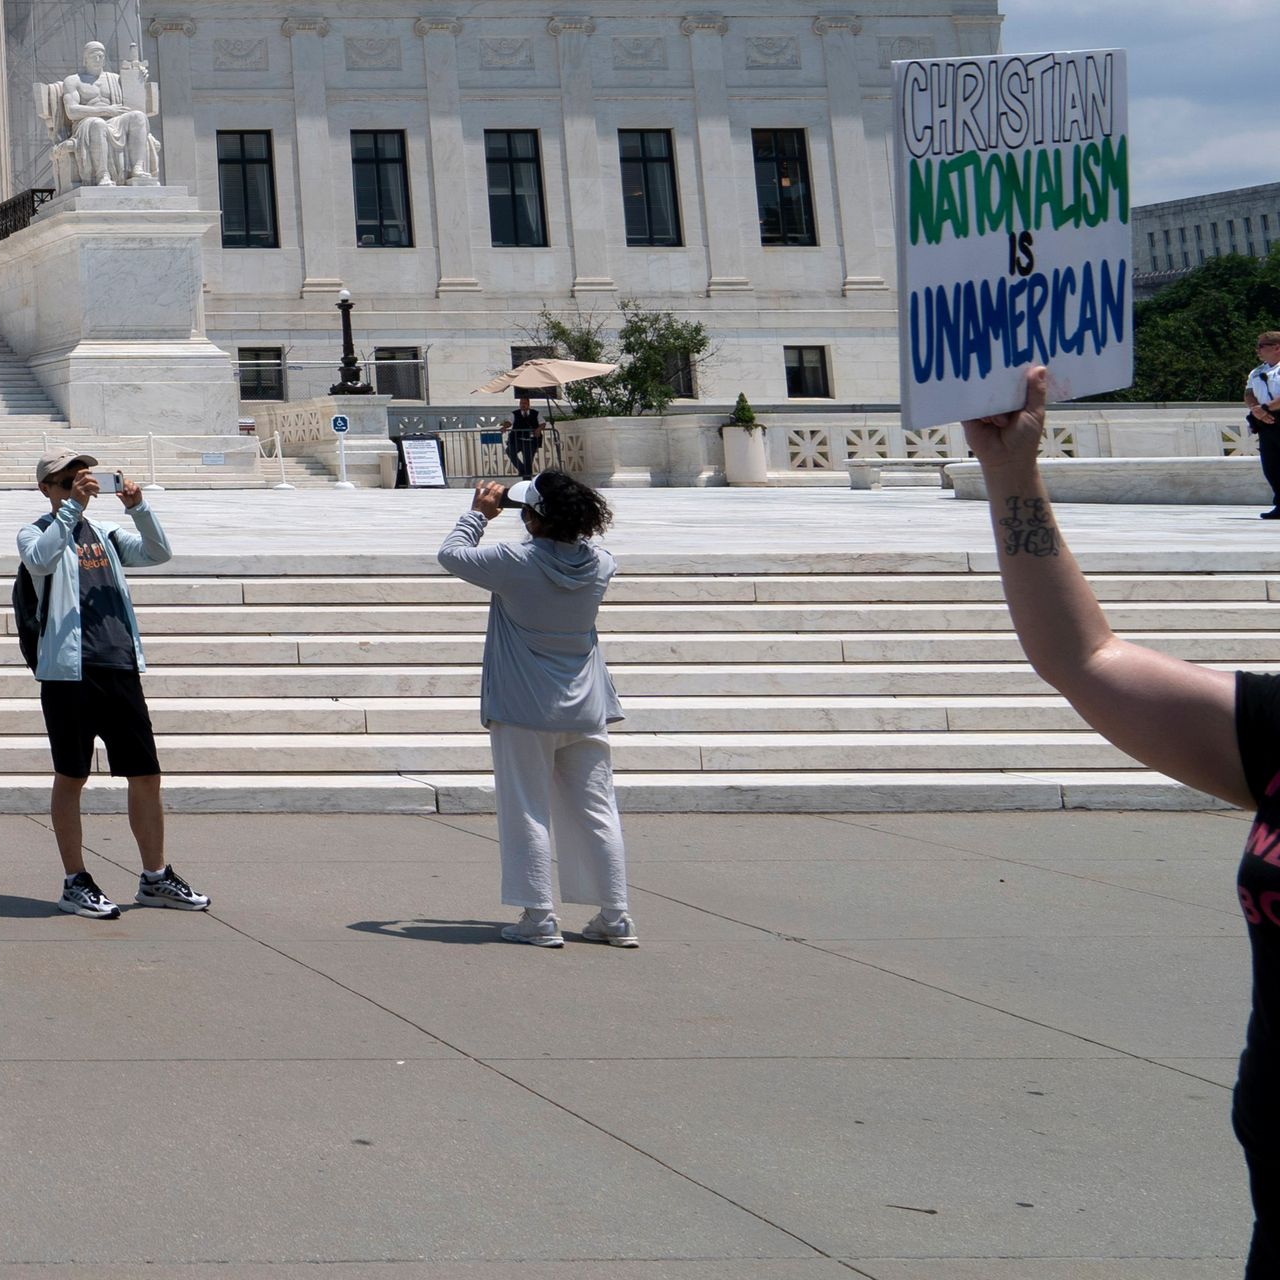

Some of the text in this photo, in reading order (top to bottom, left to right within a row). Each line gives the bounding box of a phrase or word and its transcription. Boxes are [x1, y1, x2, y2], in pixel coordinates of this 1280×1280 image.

[902, 53, 1114, 158] CHRISTIAN
[908, 135, 1128, 246] NATIONALISM
[1008, 230, 1034, 276] IS
[910, 258, 1127, 384] UNAMERICAN
